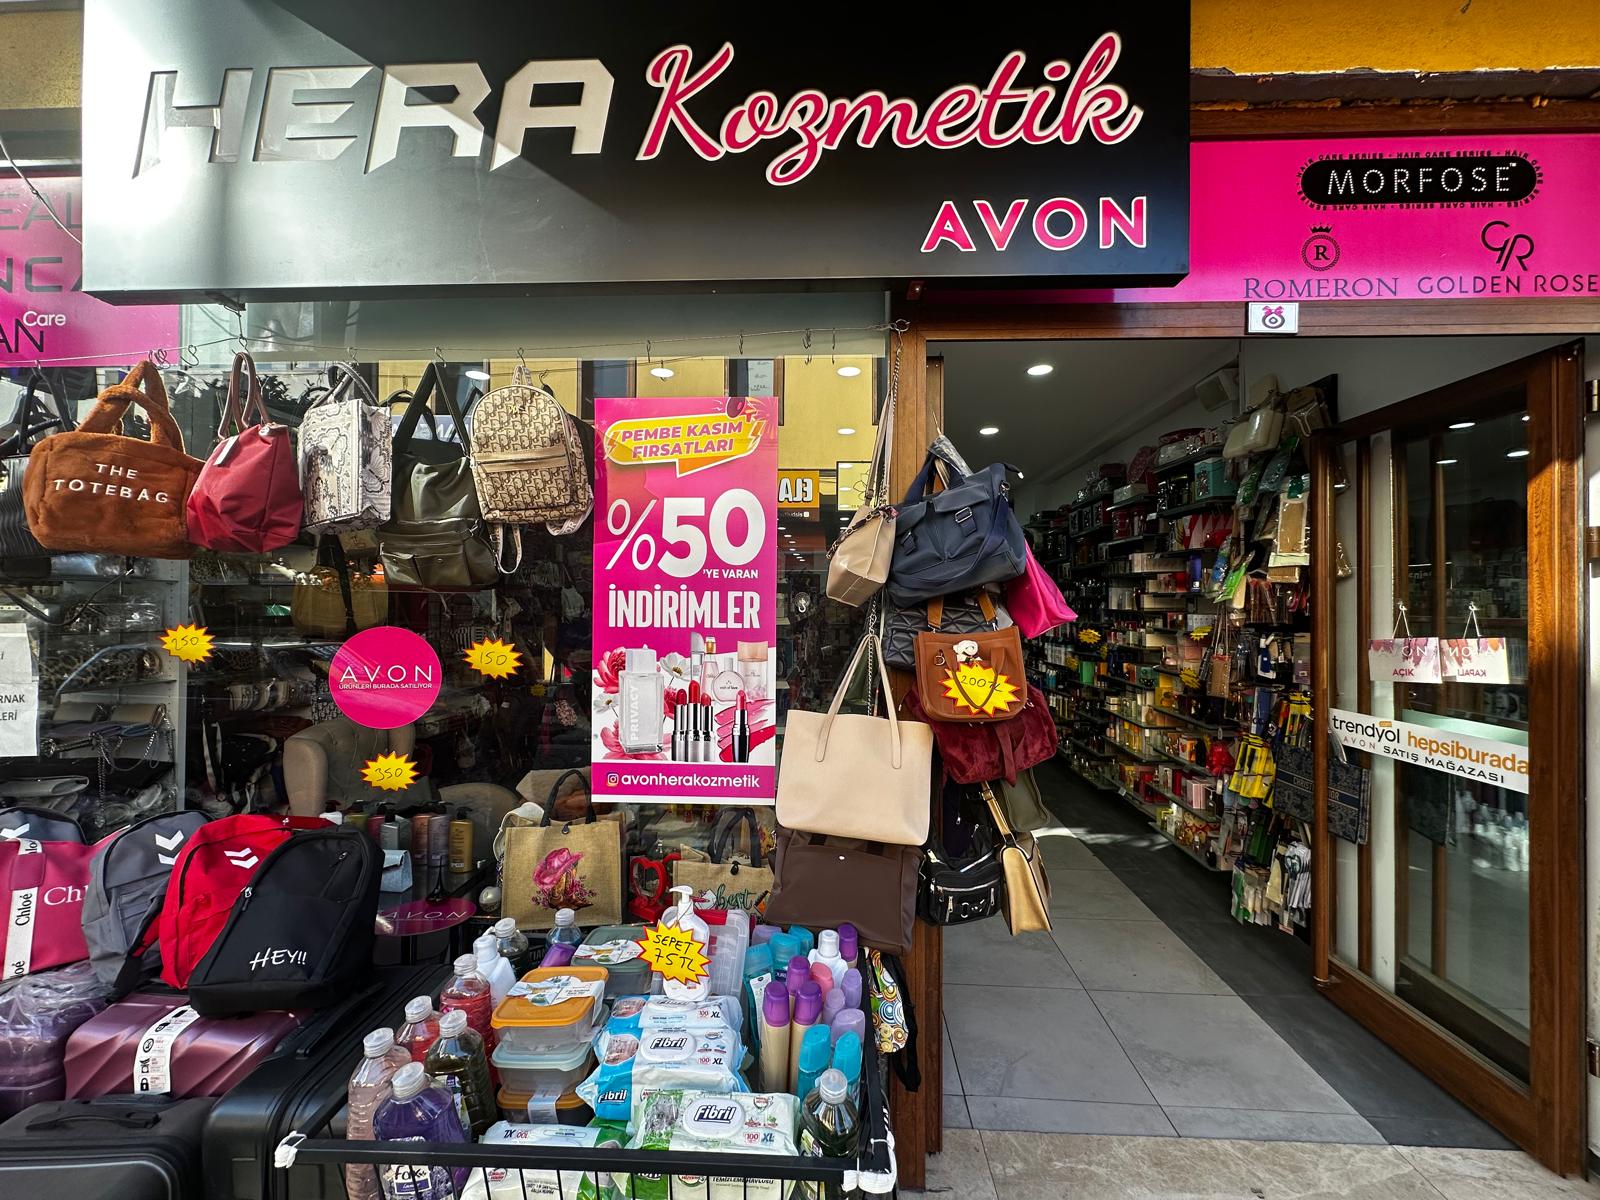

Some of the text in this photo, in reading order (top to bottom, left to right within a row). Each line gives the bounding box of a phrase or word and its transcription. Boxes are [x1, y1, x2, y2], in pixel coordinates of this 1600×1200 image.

[132, 31, 1145, 187] HERA Kozmetik
[1326, 165, 1511, 195] MORFOSE
[919, 195, 1148, 253] AVON
[1314, 244, 1329, 261] R
[1243, 276, 1400, 299] ROMERON
[1417, 273, 1599, 295] GOLDEN ROSE
[22, 310, 67, 327] Care
[621, 421, 743, 443] PEMBE KASIM
[632, 438, 734, 459] FIRSATLARI
[96, 463, 138, 480] THE
[52, 478, 170, 504] TOTEBAG
[605, 487, 767, 578] %50
[721, 568, 759, 579] VARAN
[608, 583, 761, 629] İNDİRİMLER
[479, 651, 508, 666] 150
[339, 664, 433, 683] AVON
[630, 684, 641, 741] PRIVACY
[1332, 714, 1529, 776] trendyol hepsiburada
[1342, 735, 1505, 784] AVON SATIŞ MAĞAZASI
[621, 772, 760, 788] avonherakozmetik
[715, 883, 757, 910] best
[15, 892, 33, 927] Chloé
[652, 934, 694, 955] SEPET
[249, 947, 307, 971] HEY!!
[710, 1010, 721, 1019] XL
[649, 1037, 688, 1051] Fibril
[711, 1057, 724, 1065] XL
[693, 1104, 737, 1124] Fibril
[761, 1131, 776, 1143] XL
